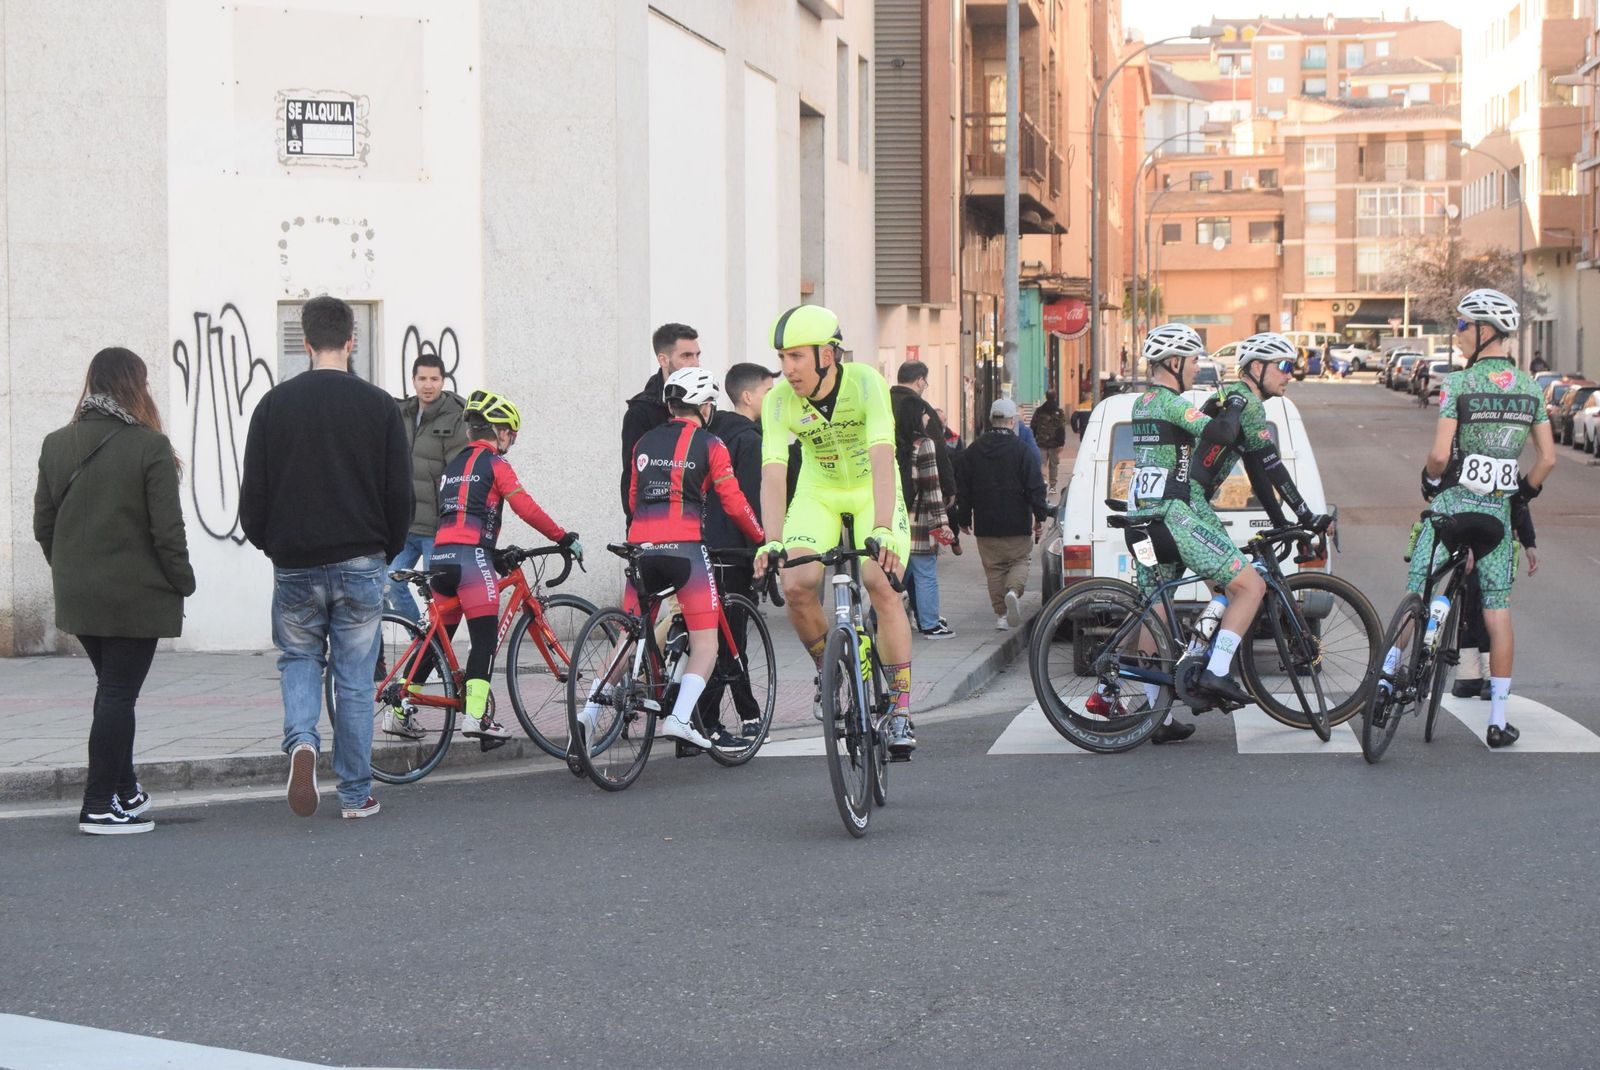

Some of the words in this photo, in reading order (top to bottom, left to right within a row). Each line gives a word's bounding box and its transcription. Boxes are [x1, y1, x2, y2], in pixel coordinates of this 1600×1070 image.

[288, 101, 302, 120] SE
[305, 103, 352, 122] ALQUILA
[1468, 398, 1535, 415] SAKATA
[1471, 411, 1501, 420] BRÓCOLI
[1132, 423, 1160, 434] AKATA
[650, 459, 696, 470] MORALEJO
[1176, 444, 1188, 483] Cricket
[1467, 459, 1493, 484] 83
[446, 474, 480, 485] MORALEJO
[1141, 472, 1162, 494] 87
[784, 535, 816, 544] ZICO
[474, 547, 488, 569] CAJA
[481, 568, 497, 602] RURAL
[700, 544, 713, 571] CAJA
[707, 572, 719, 611] RURAL
[1061, 718, 1100, 743] ONE
[1103, 718, 1153, 745] BORA
